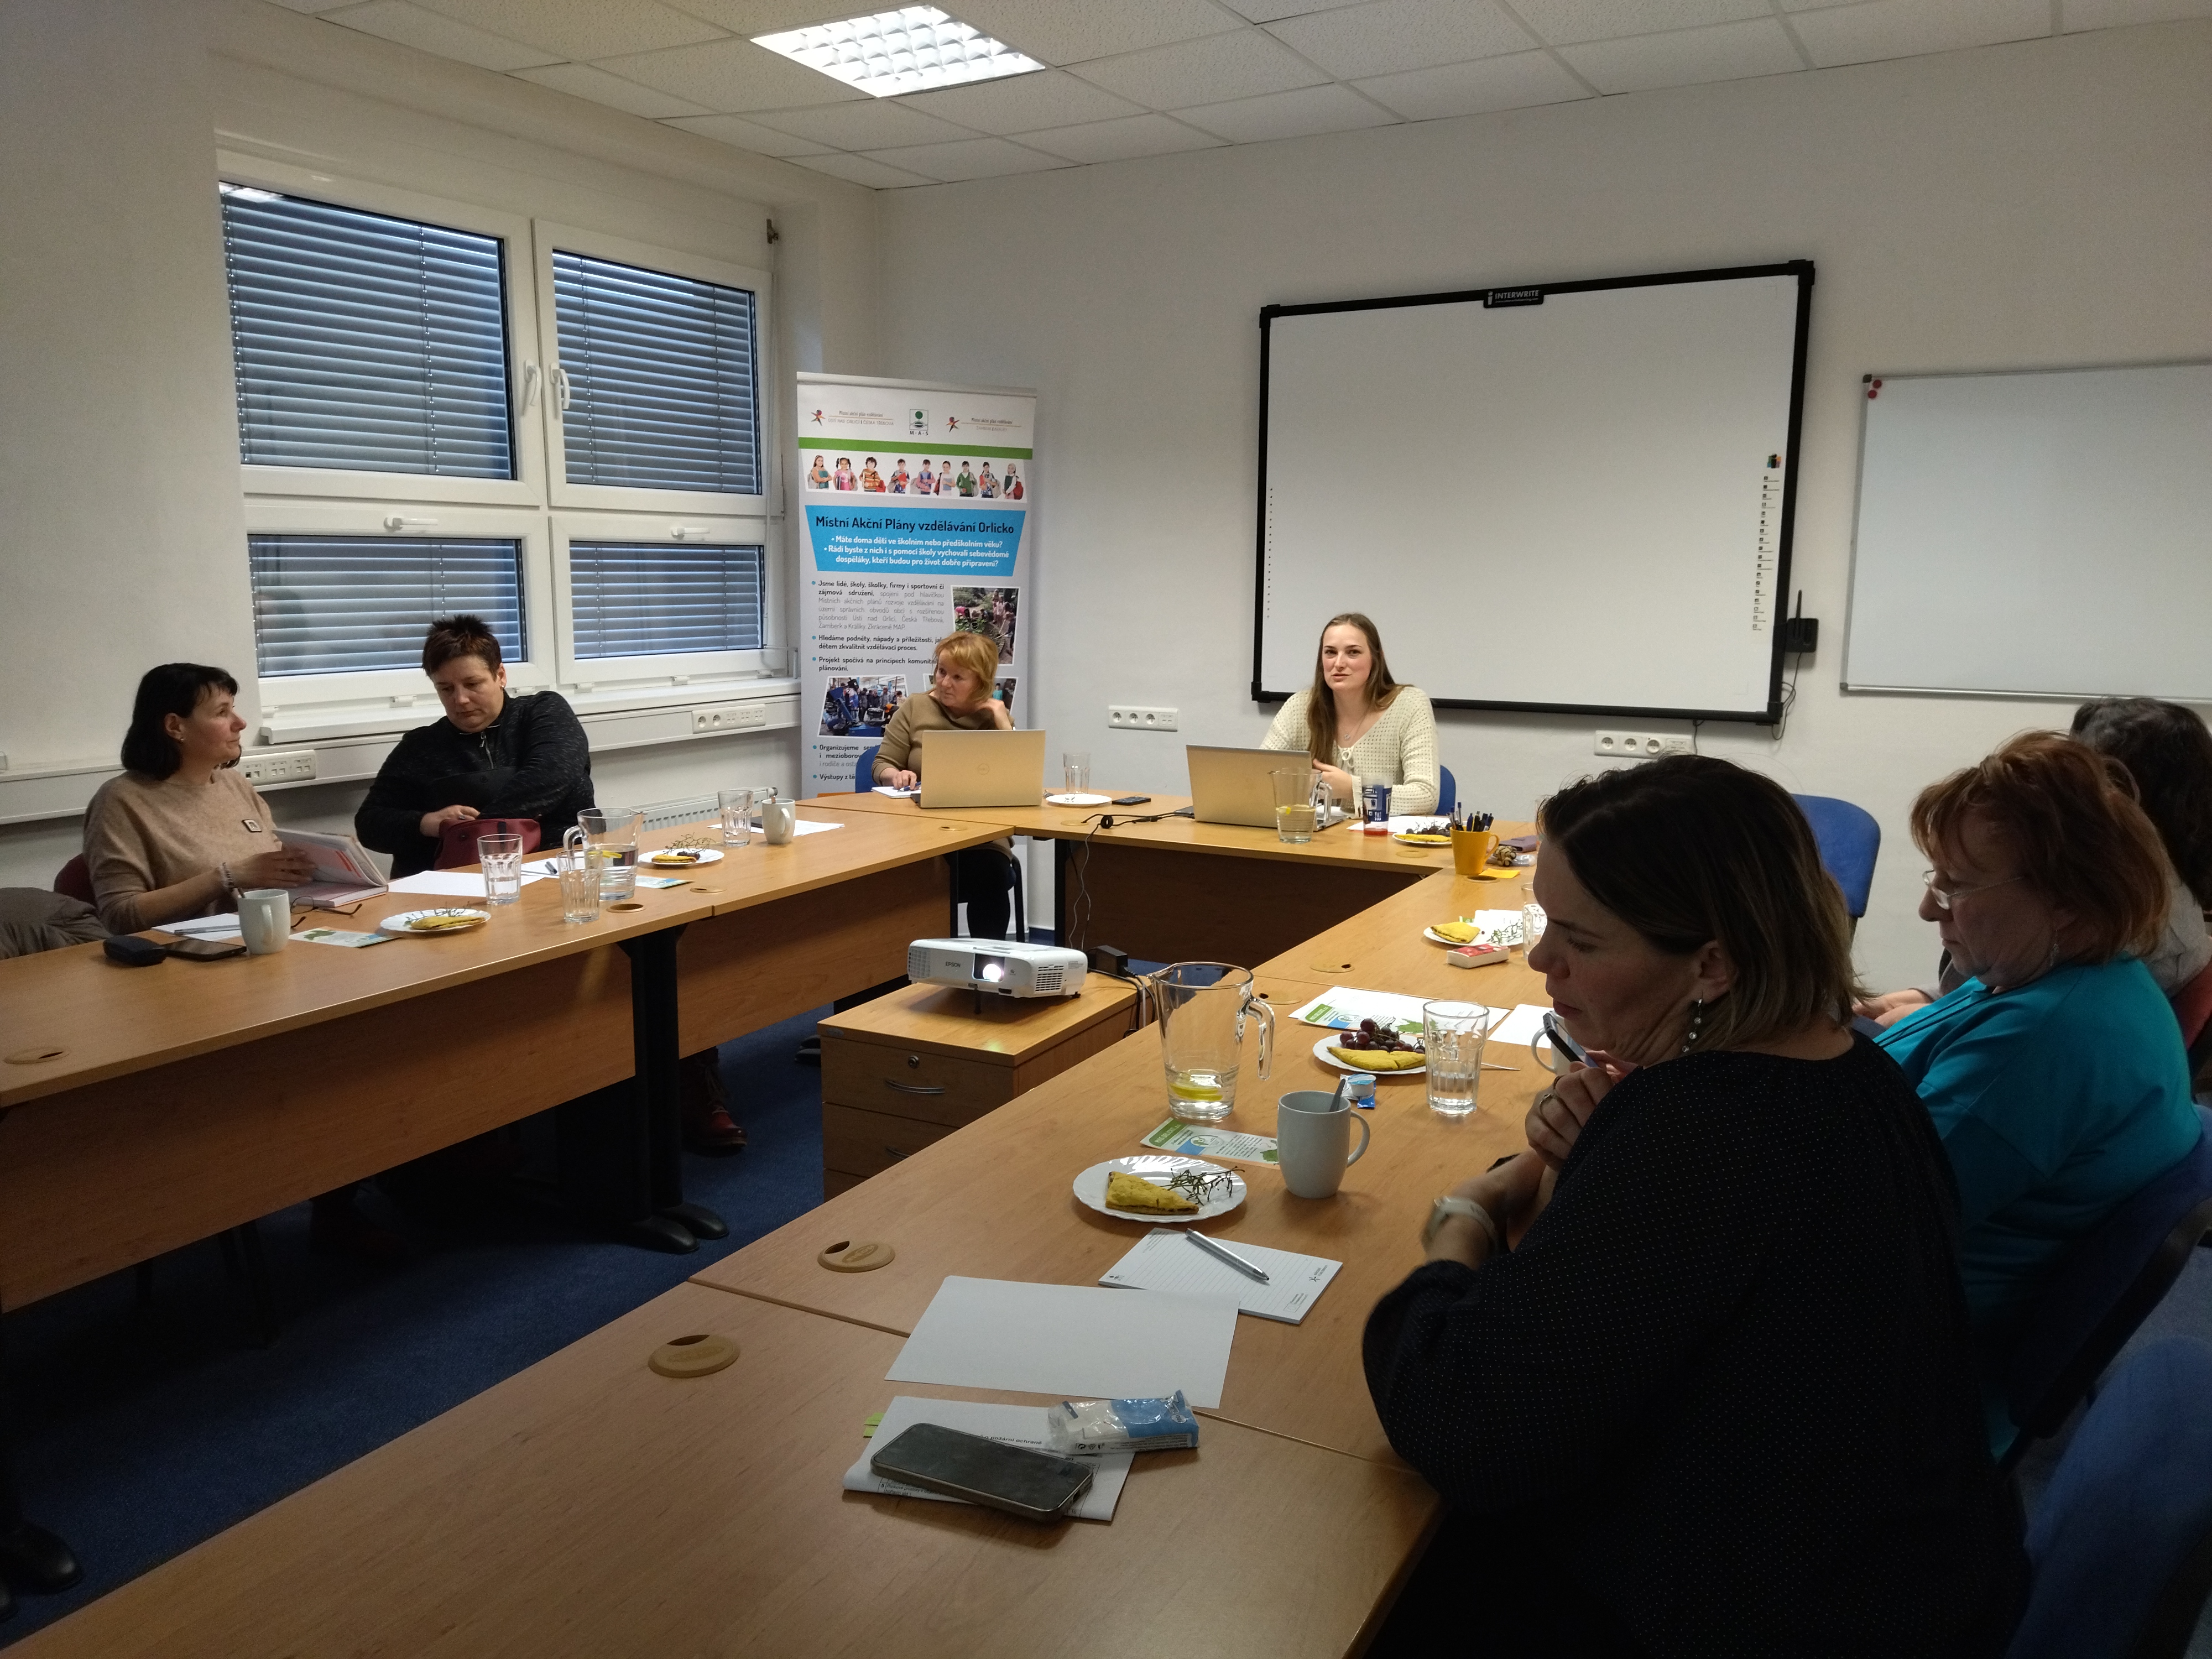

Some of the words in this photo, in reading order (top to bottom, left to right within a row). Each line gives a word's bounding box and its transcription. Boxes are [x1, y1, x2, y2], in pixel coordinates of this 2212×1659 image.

[1495, 290, 1539, 299] INTERWRITE
[816, 516, 849, 528] Místní
[852, 517, 883, 529] Akční
[885, 518, 916, 533] Plány
[919, 520, 976, 533] vzdělávání
[979, 522, 1014, 534] Orlicko
[853, 536, 873, 544] doma
[874, 536, 887, 545] děti
[898, 538, 924, 546] školním
[942, 539, 983, 548] předškolním
[844, 546, 863, 555] byste
[919, 548, 936, 557] školy
[937, 549, 968, 558] vychovali
[969, 550, 1009, 558] sebevědomé
[836, 555, 871, 565] dospěláky,
[818, 620, 843, 629] Žamberk
